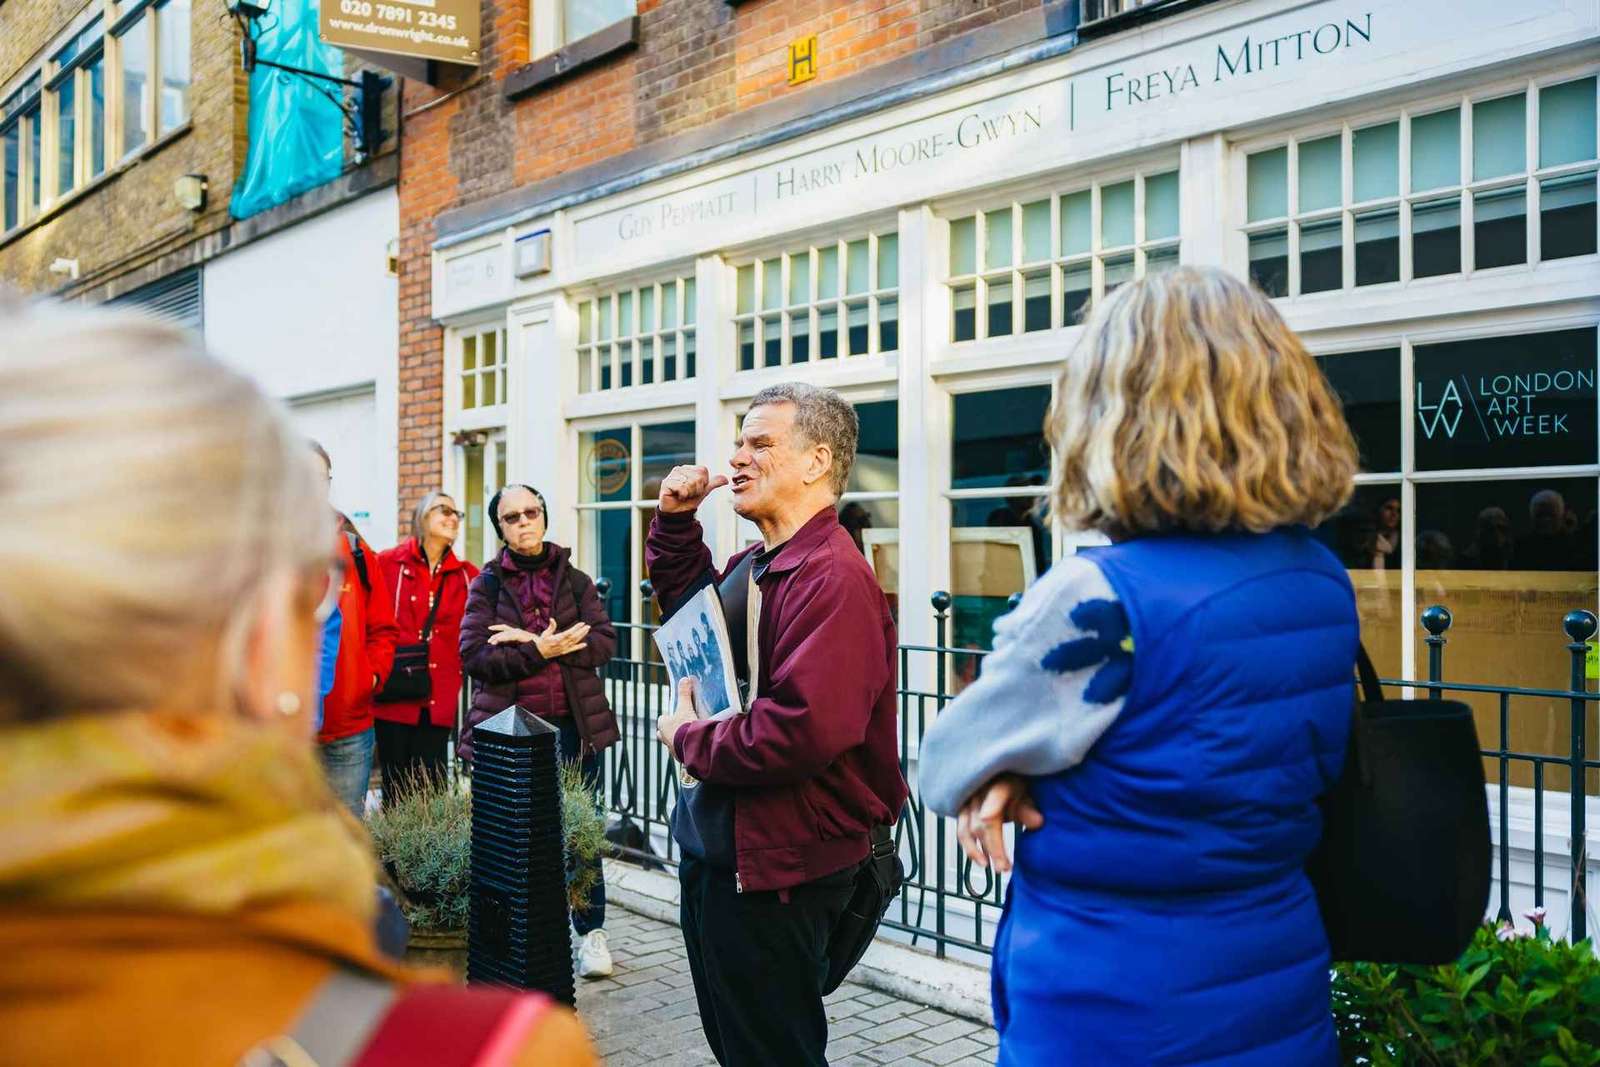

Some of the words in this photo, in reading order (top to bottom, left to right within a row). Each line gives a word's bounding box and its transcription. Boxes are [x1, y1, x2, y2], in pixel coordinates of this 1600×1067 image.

[340, 0, 372, 17] 020
[375, 4, 413, 23] 7891
[417, 10, 457, 30] 2345
[788, 36, 817, 81] H
[1105, 63, 1200, 111] FREYA
[1214, 13, 1373, 82] MITTON
[777, 166, 845, 198] HARRY
[854, 105, 1042, 179] MOORE-GWYN
[1480, 368, 1594, 396] LONDON
[1487, 394, 1536, 416] ART
[1493, 413, 1569, 436] WEEK
